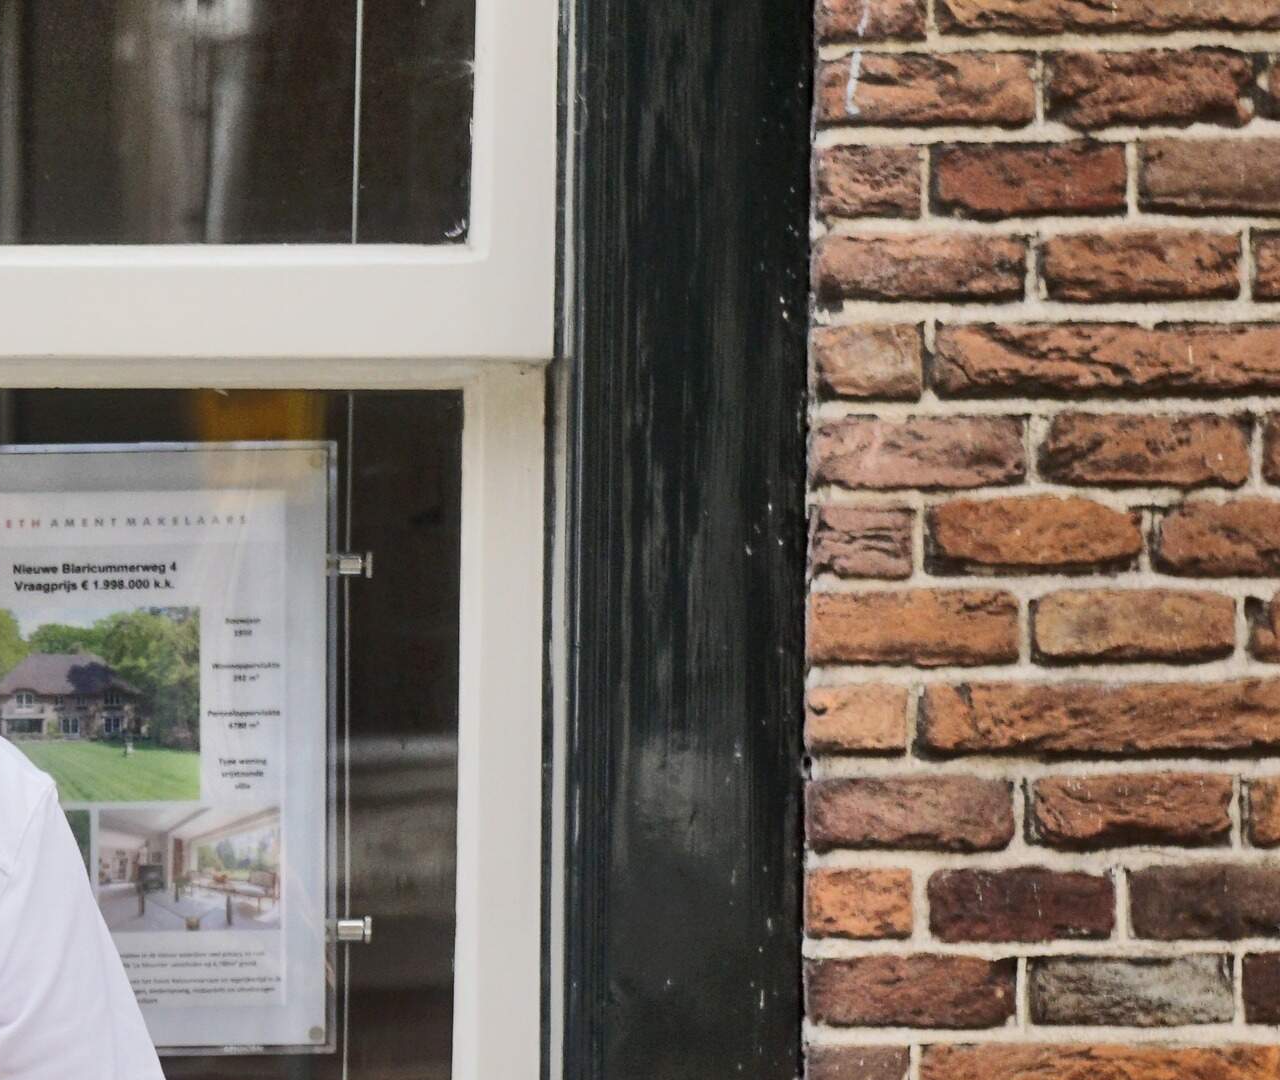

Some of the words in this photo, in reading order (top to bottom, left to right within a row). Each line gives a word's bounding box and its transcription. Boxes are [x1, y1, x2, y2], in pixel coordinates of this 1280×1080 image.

[49, 517, 118, 528] AMENT
[125, 515, 246, 527] MAKELAARS
[12, 563, 59, 575] Nieuwe
[61, 562, 167, 576] Blaricummerweg
[169, 562, 177, 573] 4
[13, 580, 78, 593] Vraagprijs
[80, 580, 89, 591] €
[153, 579, 175, 589] k.k.
